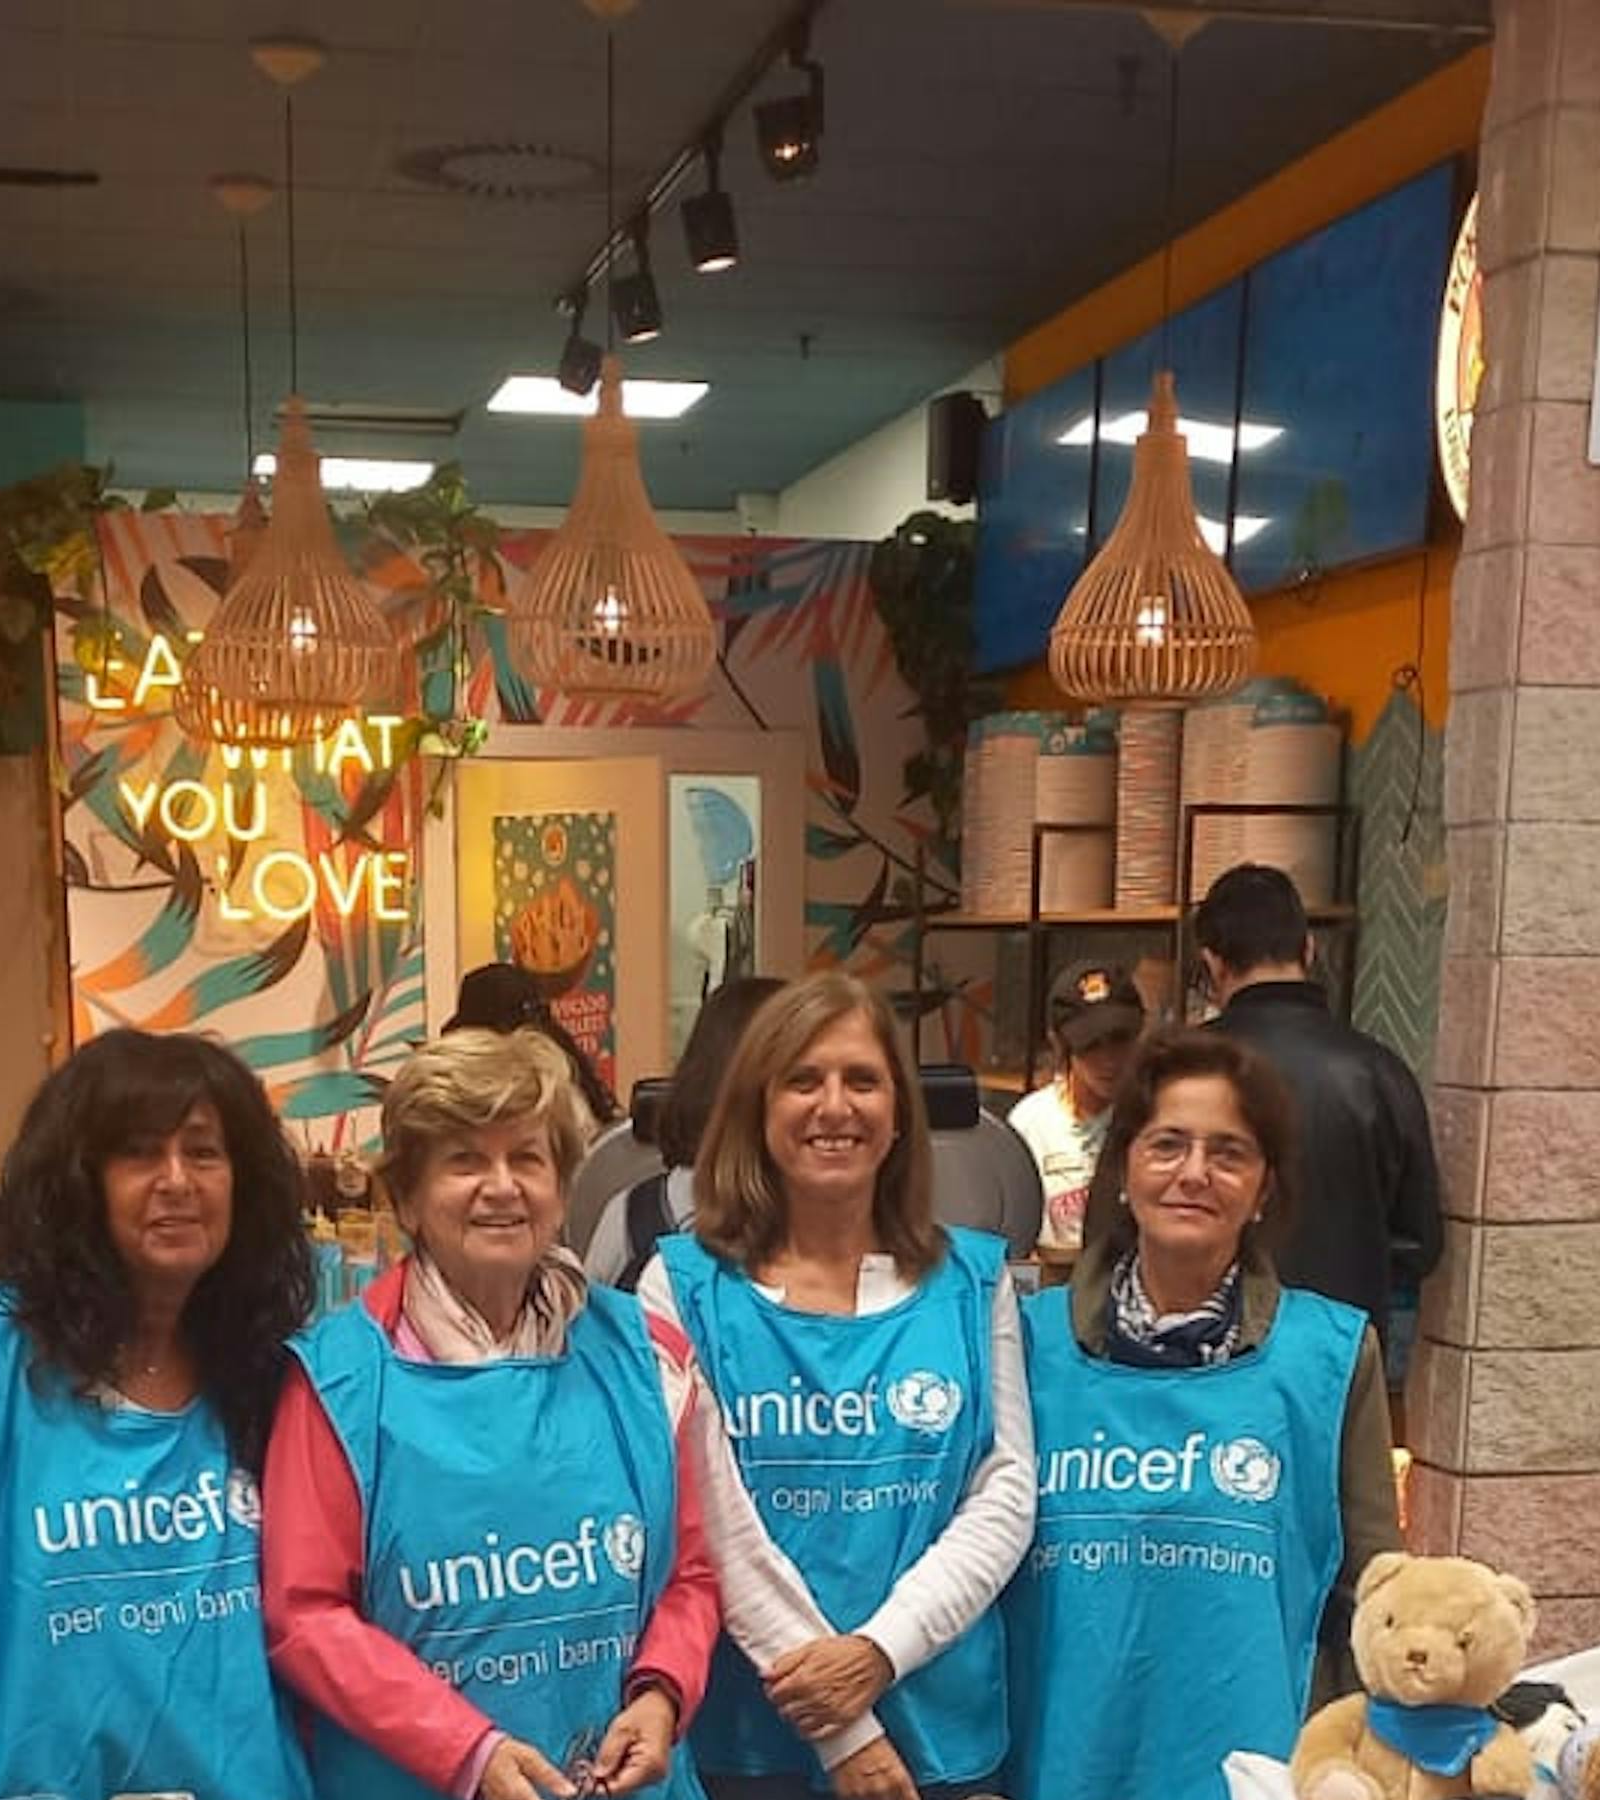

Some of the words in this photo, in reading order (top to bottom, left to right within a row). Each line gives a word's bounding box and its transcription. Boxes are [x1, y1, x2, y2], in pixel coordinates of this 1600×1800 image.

[85, 632, 208, 709] EA
[118, 779, 268, 842] YOU
[215, 850, 410, 922] LOVE
[724, 1374, 880, 1437] unicef
[1038, 1430, 1208, 1497] unicef
[34, 1471, 226, 1553] unicef
[399, 1517, 599, 1610] unicef
[1068, 1535, 1129, 1571] ogni
[1140, 1534, 1276, 1579] bambino
[50, 1605, 104, 1645] per
[119, 1592, 187, 1634] ogni
[474, 1641, 549, 1686] ogni
